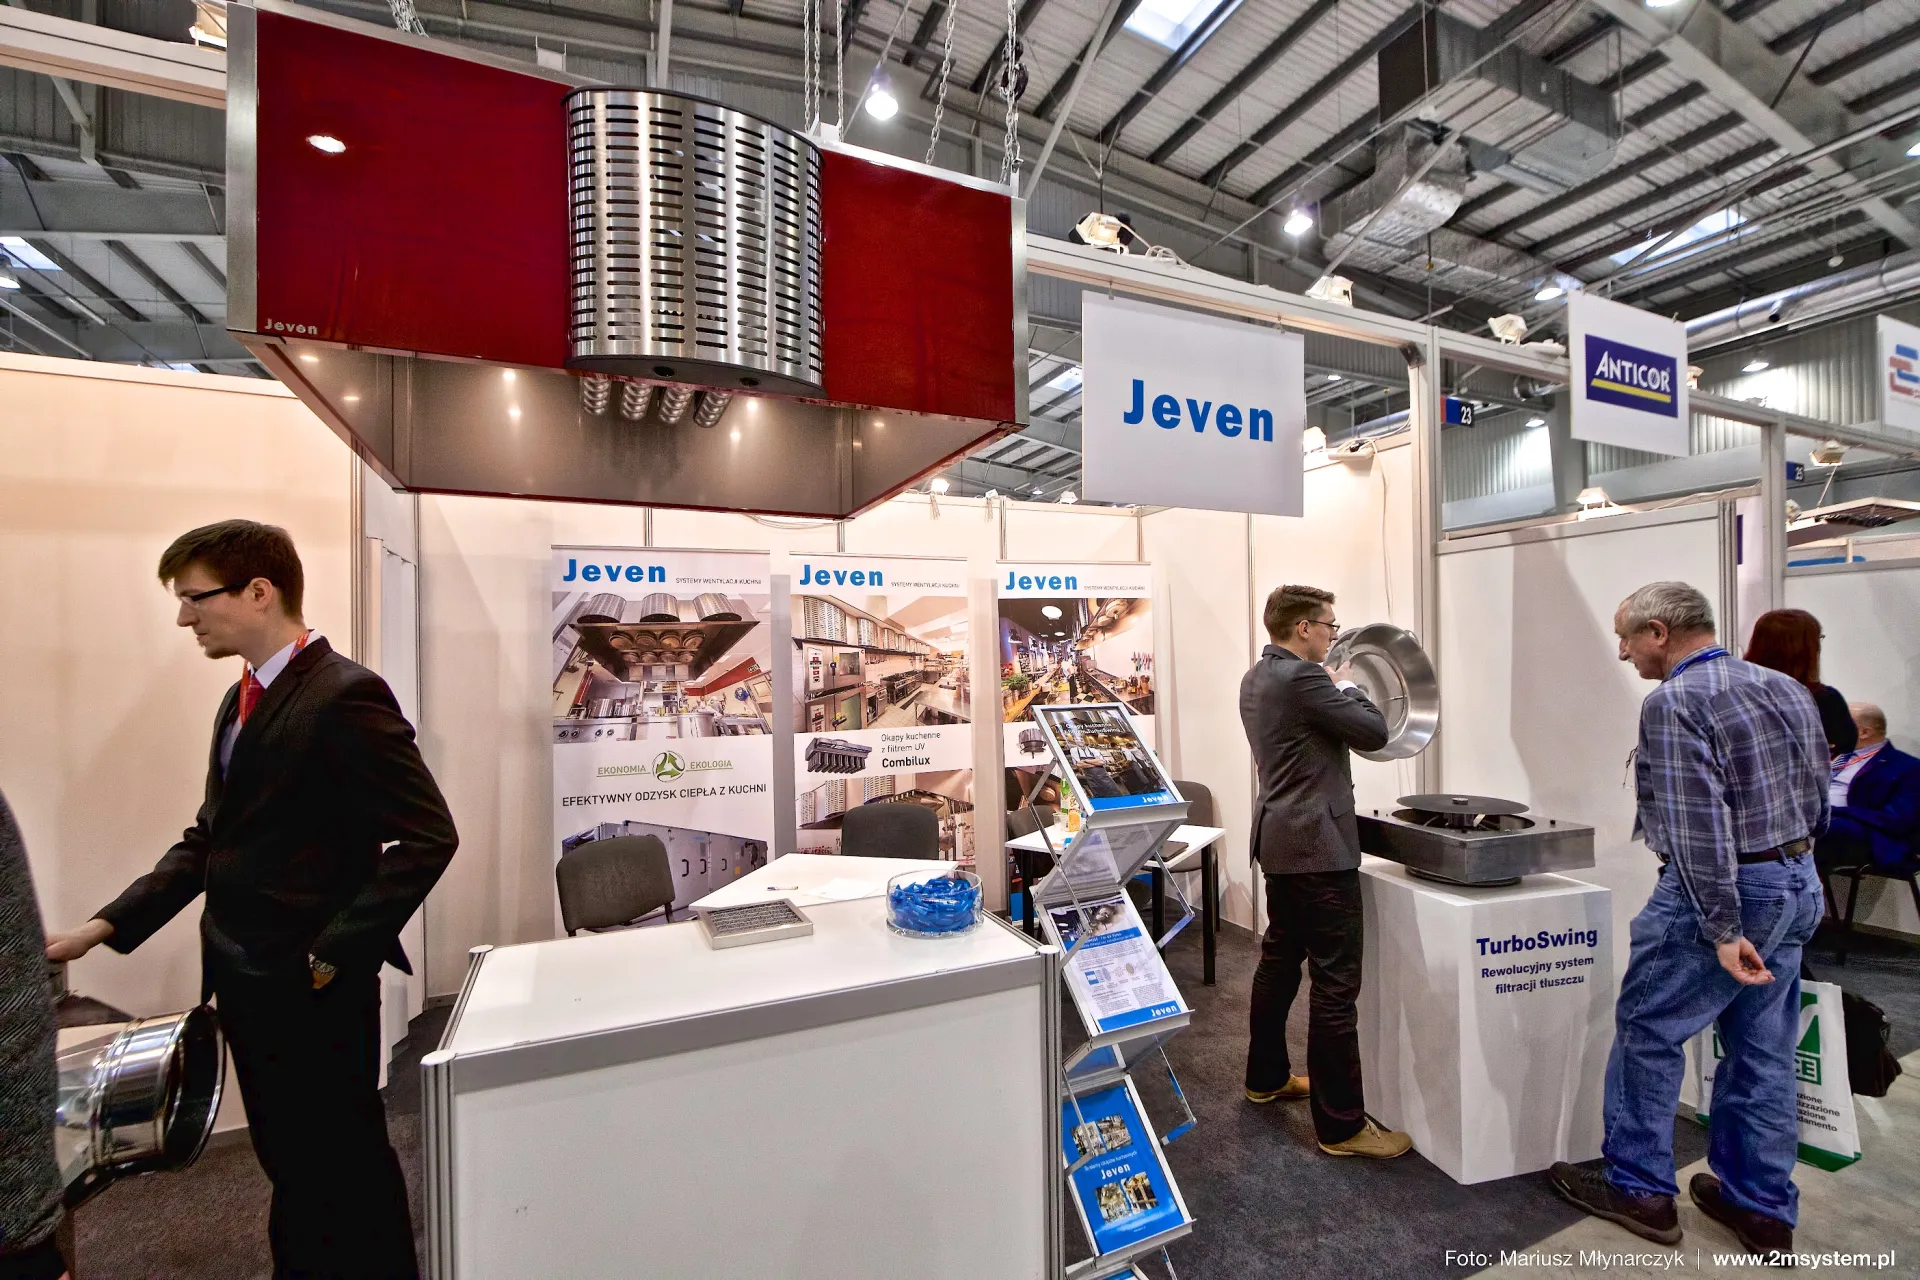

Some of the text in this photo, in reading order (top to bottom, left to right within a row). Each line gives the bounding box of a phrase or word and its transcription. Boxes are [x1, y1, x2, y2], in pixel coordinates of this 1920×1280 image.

[264, 318, 318, 335] Jeven
[1595, 350, 1671, 393] ANTICOR
[1123, 378, 1274, 443] Jeven
[1460, 405, 1472, 425] 23
[563, 558, 666, 583] Jeven
[799, 564, 884, 587] Jeven
[1005, 571, 1078, 591] Jeven
[881, 732, 941, 743] Okapy kuchenne
[887, 744, 913, 753] filtrem
[914, 742, 926, 751] UV
[597, 764, 647, 775] EKONOMIA
[690, 759, 733, 770] EKOLOGIA
[882, 755, 931, 768] Combilux
[562, 783, 767, 807] EFEKTYWNY ODZYSK CIEPŁA Z KUCHNI
[1142, 794, 1169, 804] Jeven
[1476, 928, 1598, 956] TurboSwing
[1481, 957, 1595, 979] Rewolucyjny system
[1496, 975, 1585, 994] filtracji tłuszczu
[1151, 1004, 1178, 1018] Jeven
[1101, 1163, 1131, 1180] Jeven
